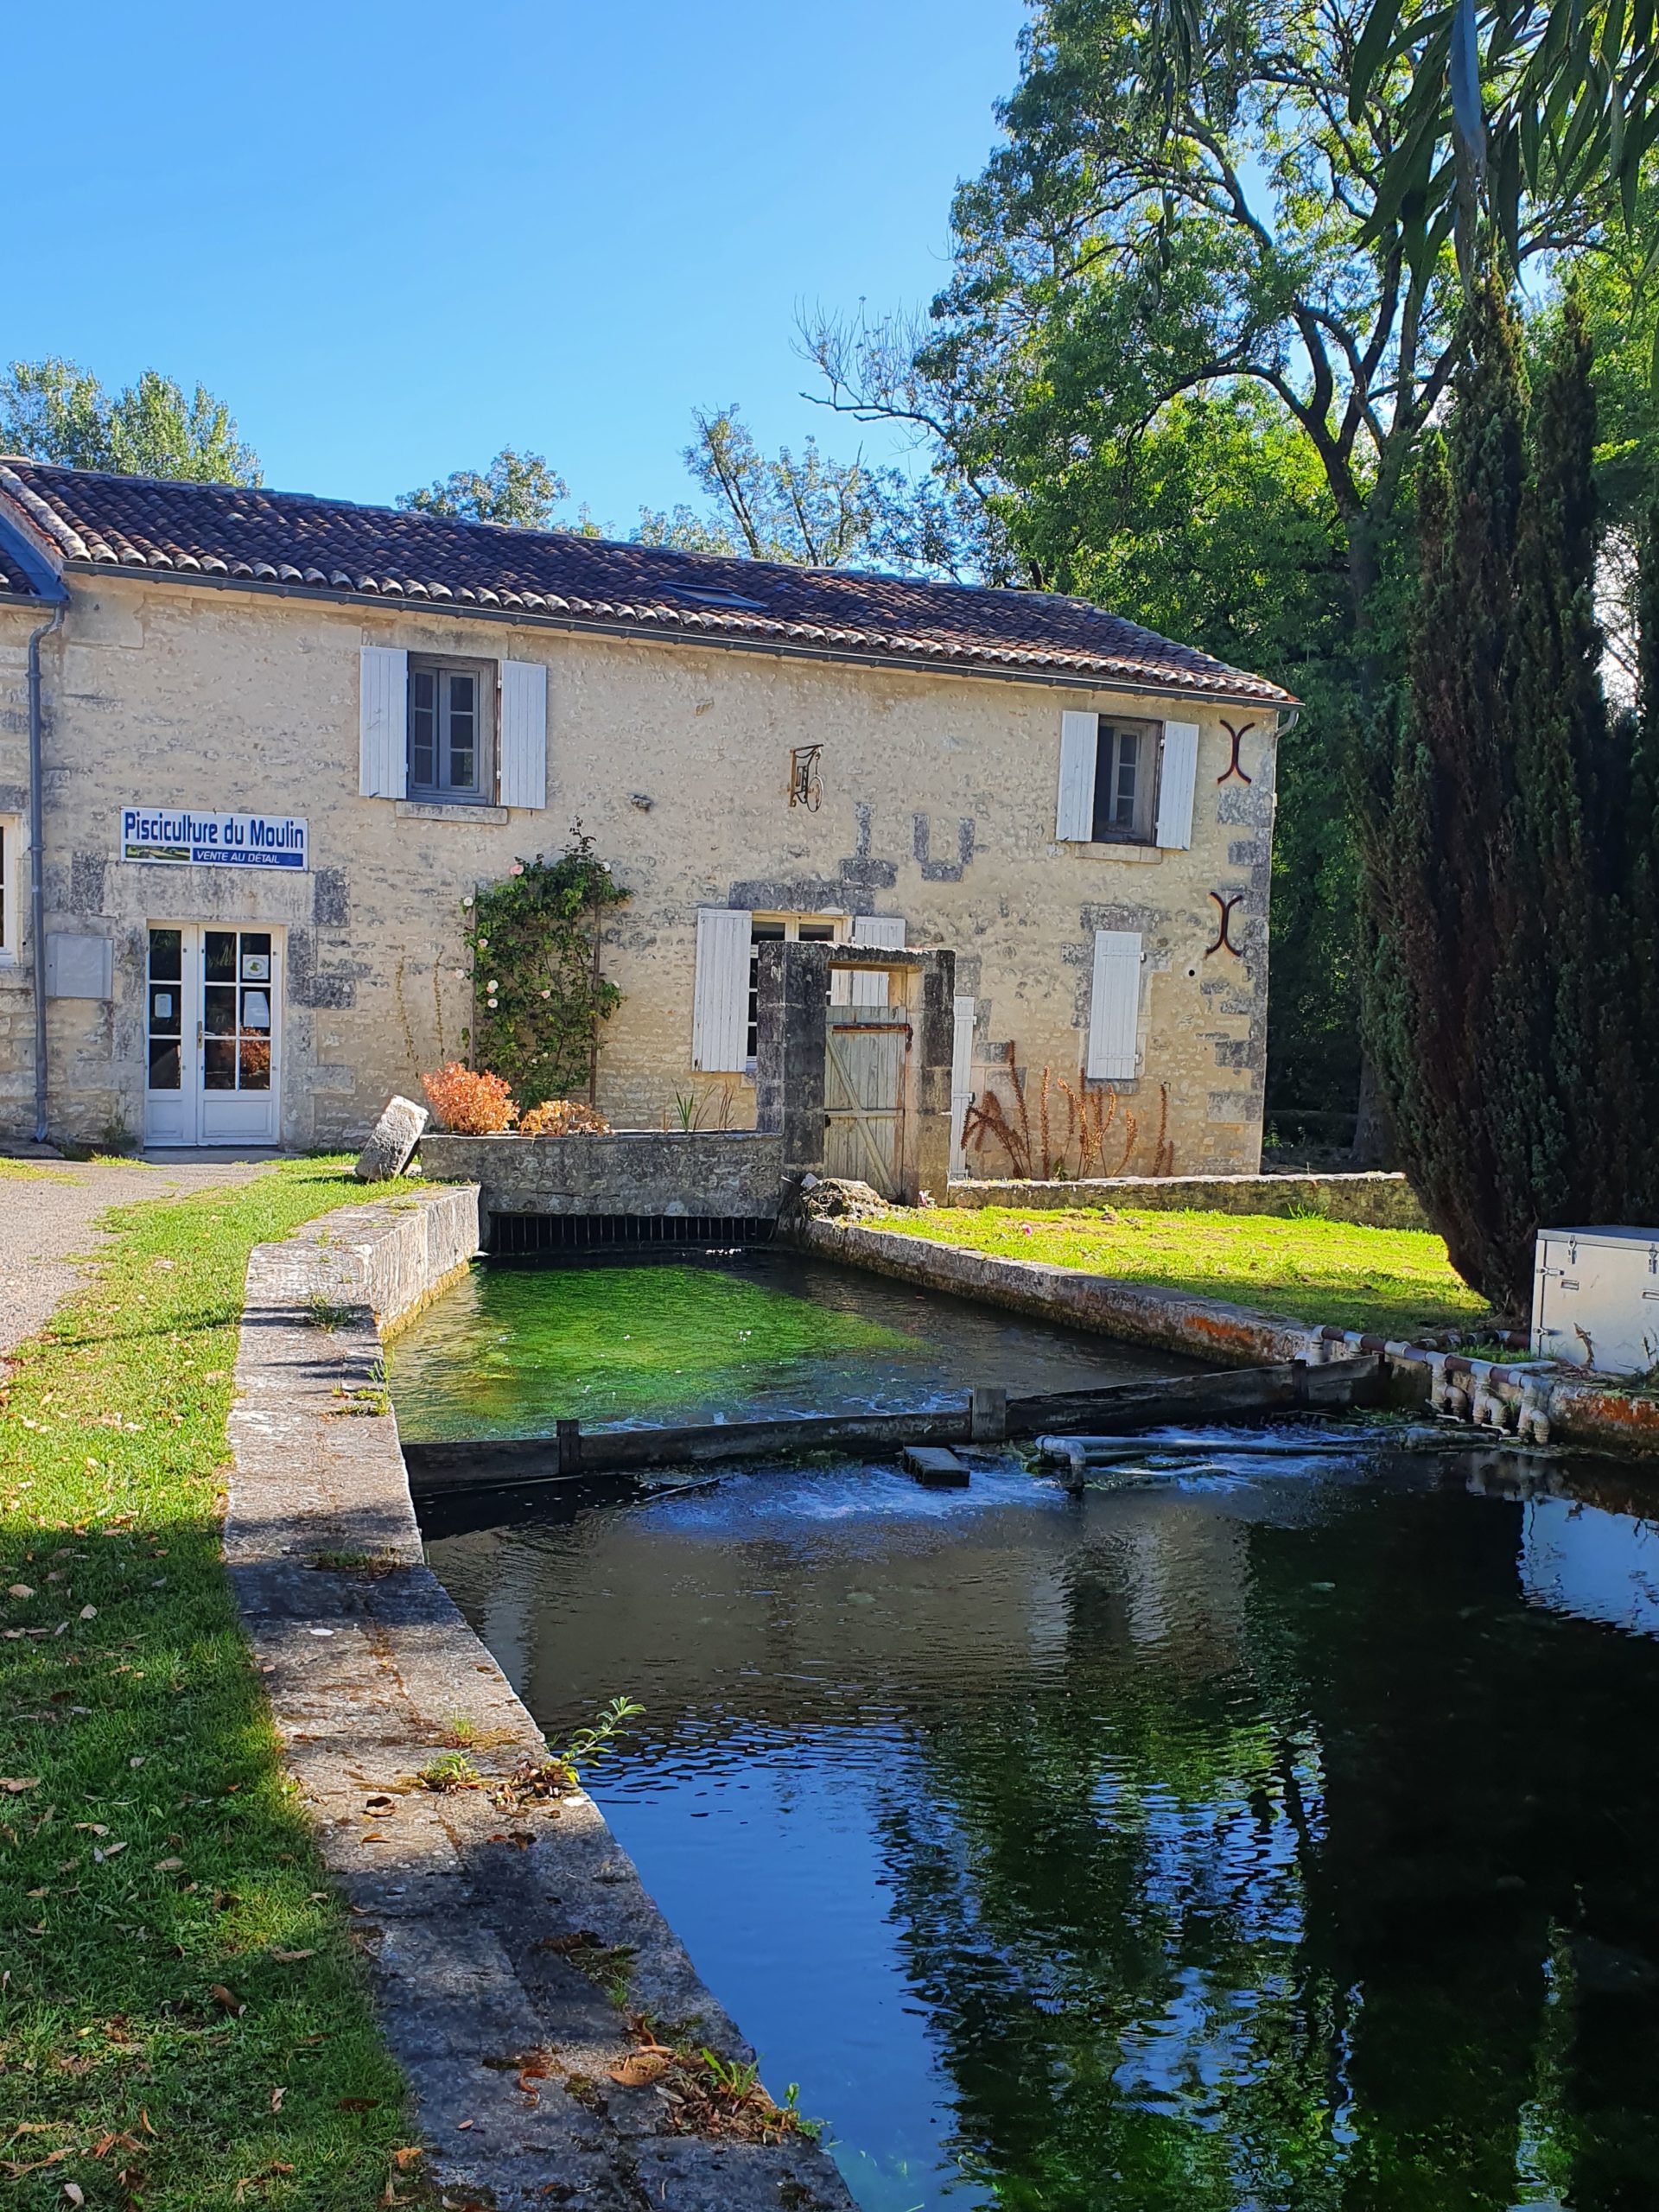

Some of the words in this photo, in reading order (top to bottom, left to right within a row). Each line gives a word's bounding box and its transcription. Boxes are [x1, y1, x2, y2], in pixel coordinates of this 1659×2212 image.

[124, 811, 218, 843] Pisciculture
[224, 817, 244, 845] du
[251, 819, 303, 849] Moulin
[197, 850, 229, 861] VENTE
[230, 852, 245, 861] AU
[247, 852, 280, 863] DÉTAIL
